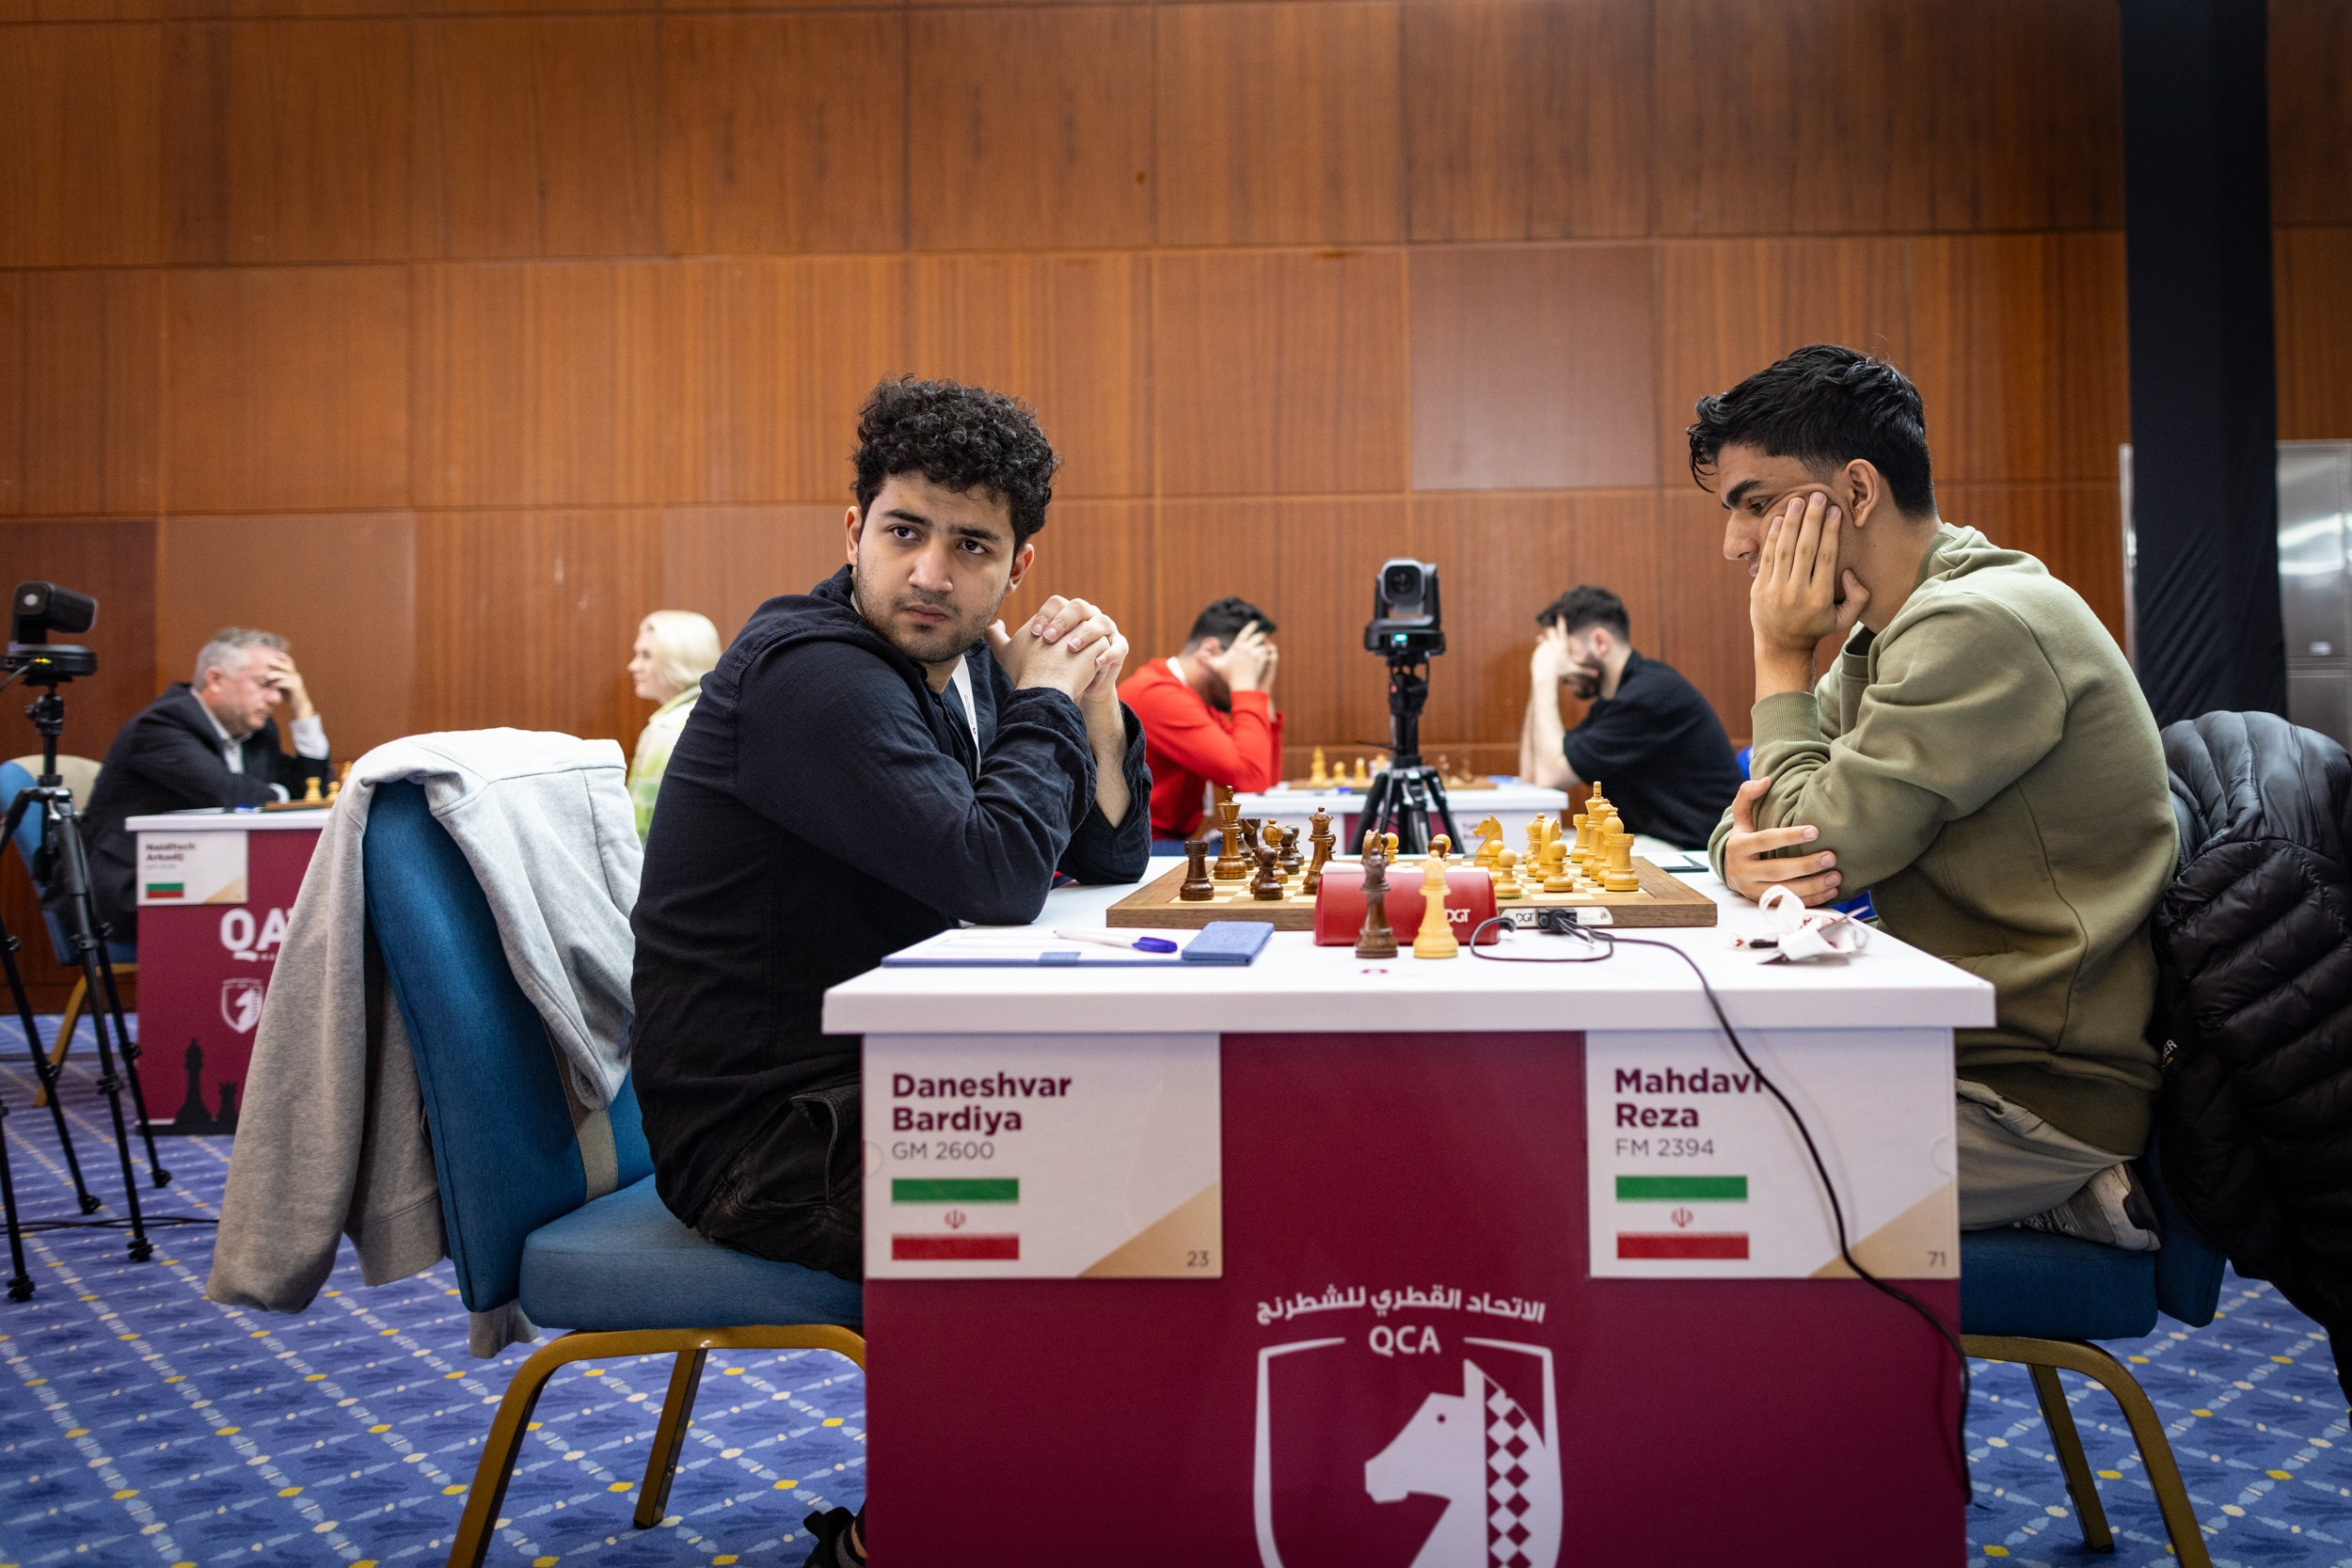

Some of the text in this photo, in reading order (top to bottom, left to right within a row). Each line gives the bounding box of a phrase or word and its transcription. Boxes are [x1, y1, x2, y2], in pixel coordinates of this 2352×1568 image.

[1516, 913, 1534, 923] DGT
[892, 1072, 1072, 1099] Daneshvar
[1614, 1068, 1762, 1094] Mahdavi
[892, 1105, 1023, 1136] Bardiya
[1615, 1102, 1700, 1129] Reza
[892, 1141, 994, 1161] GM 2600
[1615, 1138, 1714, 1157] FM 2394
[1186, 1250, 1210, 1267] 23
[1927, 1251, 1947, 1267] 71
[1256, 1284, 1546, 1325] الاتحاد القطري للشطرنج
[1368, 1325, 1441, 1357] QCA
